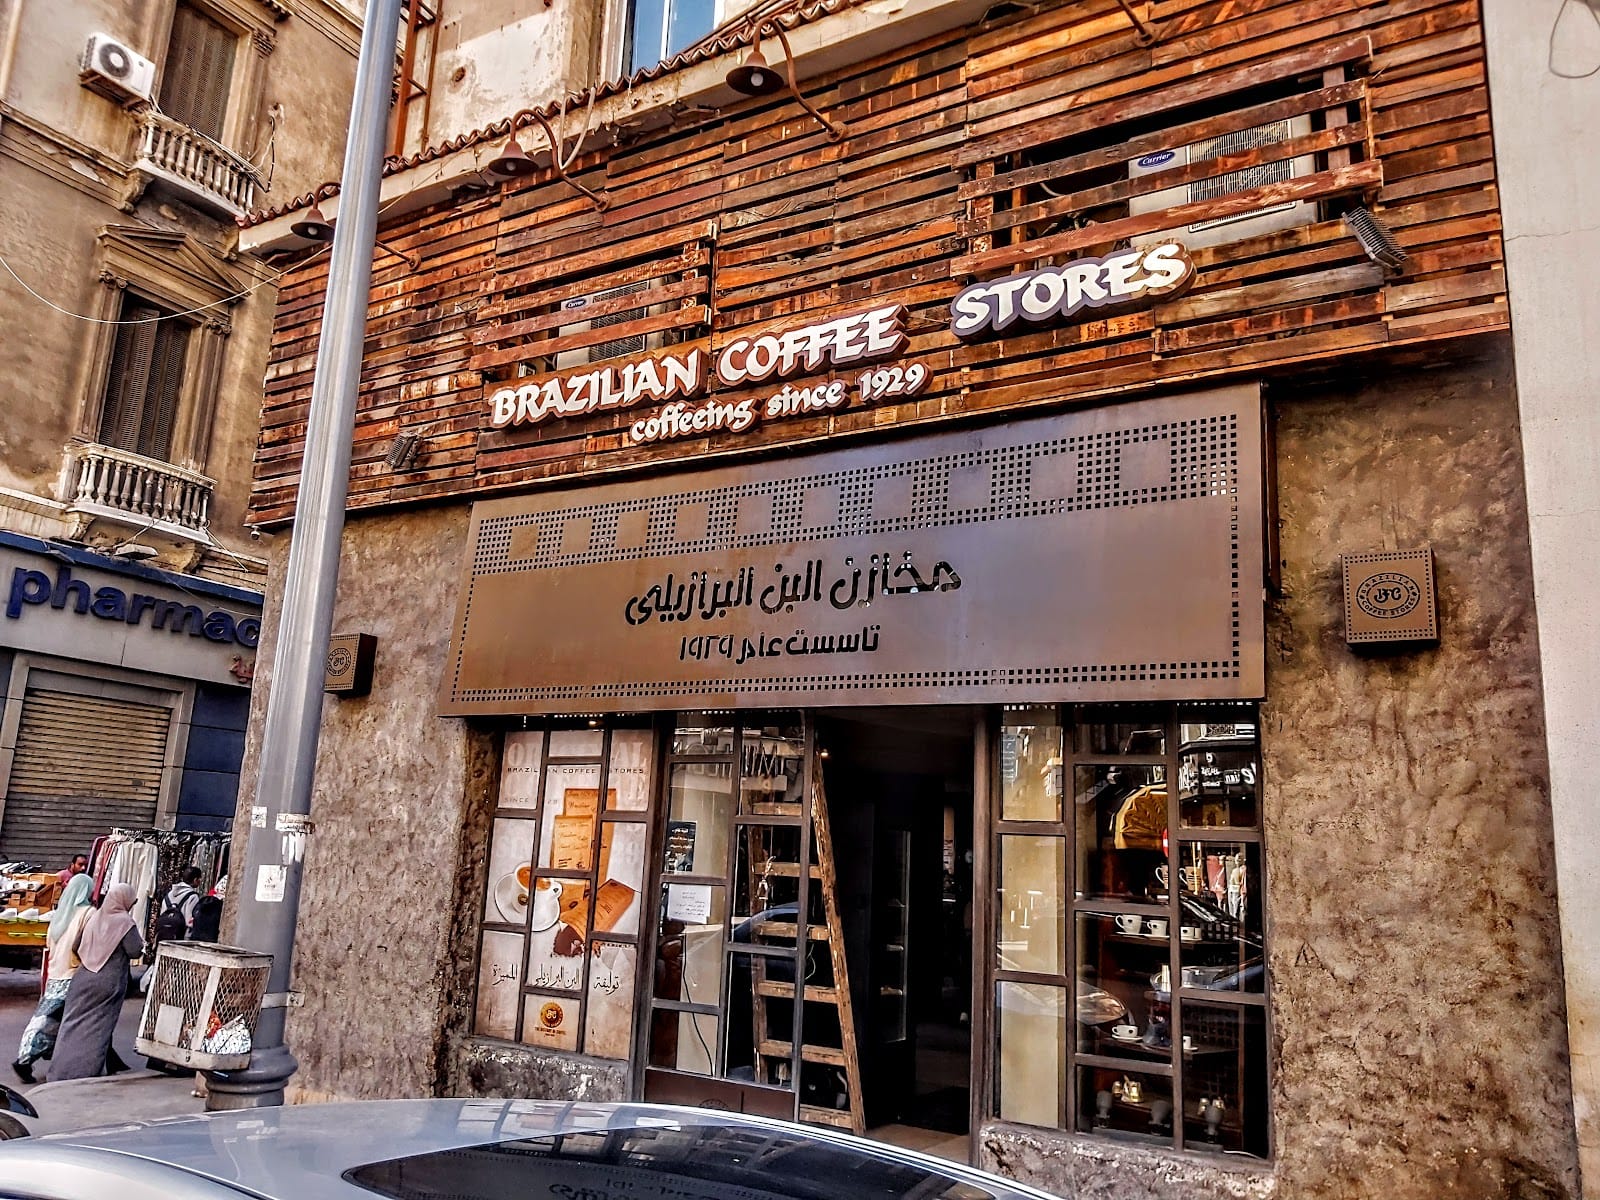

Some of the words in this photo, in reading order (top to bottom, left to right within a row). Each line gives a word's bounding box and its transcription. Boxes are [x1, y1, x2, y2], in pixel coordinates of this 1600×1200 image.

[1142, 153, 1171, 165] Carrier
[490, 350, 699, 427] BRAZILIAN
[717, 305, 904, 382] COFFEE
[954, 243, 1187, 331] STORES
[631, 398, 754, 441] coffeeing
[766, 381, 841, 417] since
[859, 363, 928, 400] 1929
[760, 559, 823, 614] البن
[830, 551, 962, 609] مخازن
[736, 632, 783, 664] عام
